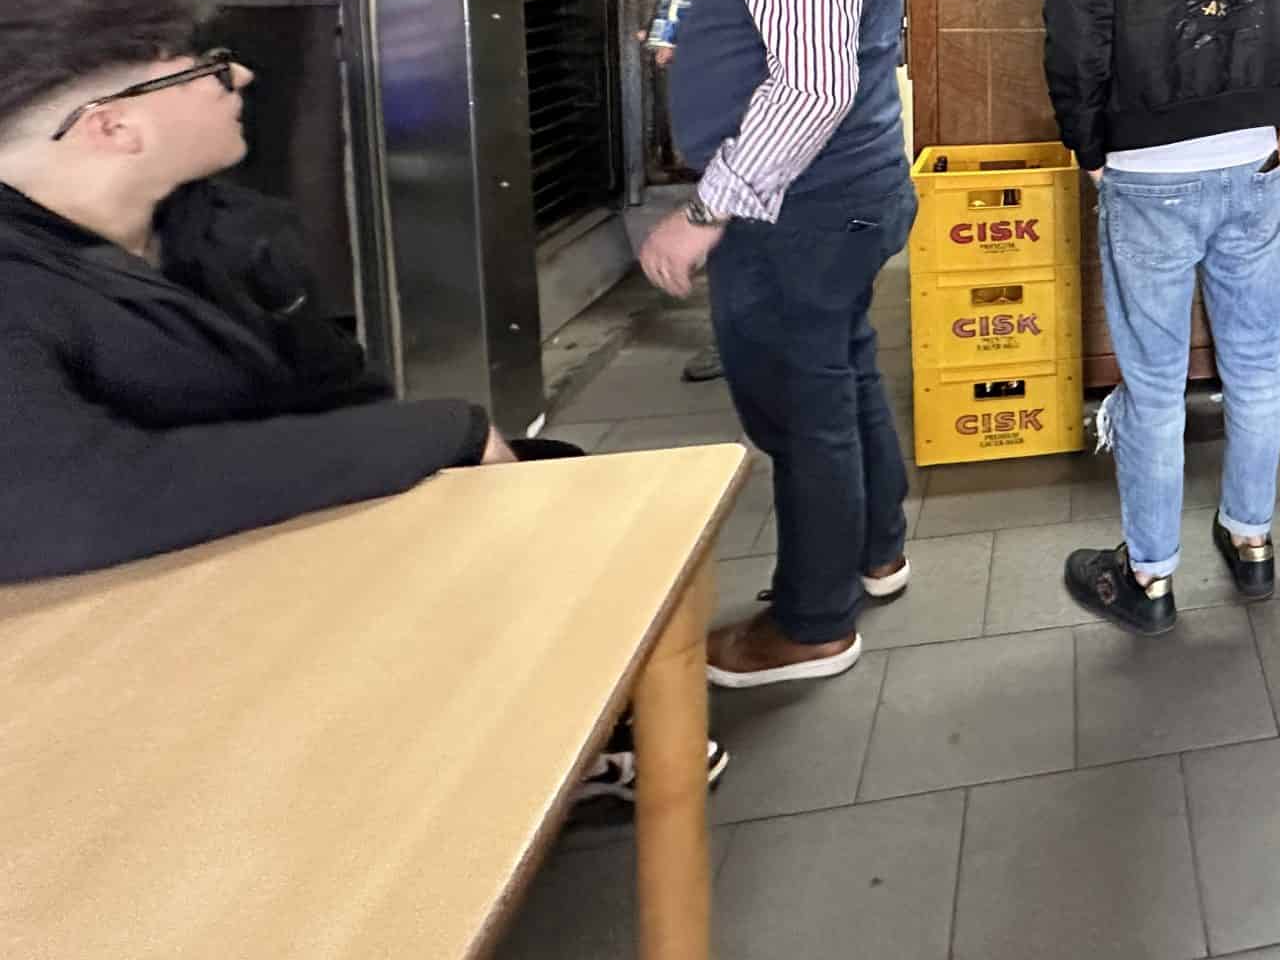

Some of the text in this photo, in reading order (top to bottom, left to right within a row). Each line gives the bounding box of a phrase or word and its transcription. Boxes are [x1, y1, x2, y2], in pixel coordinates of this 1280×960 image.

[949, 219, 1040, 244] CISK
[952, 314, 1042, 338] CISK
[955, 408, 1045, 435] CISK
